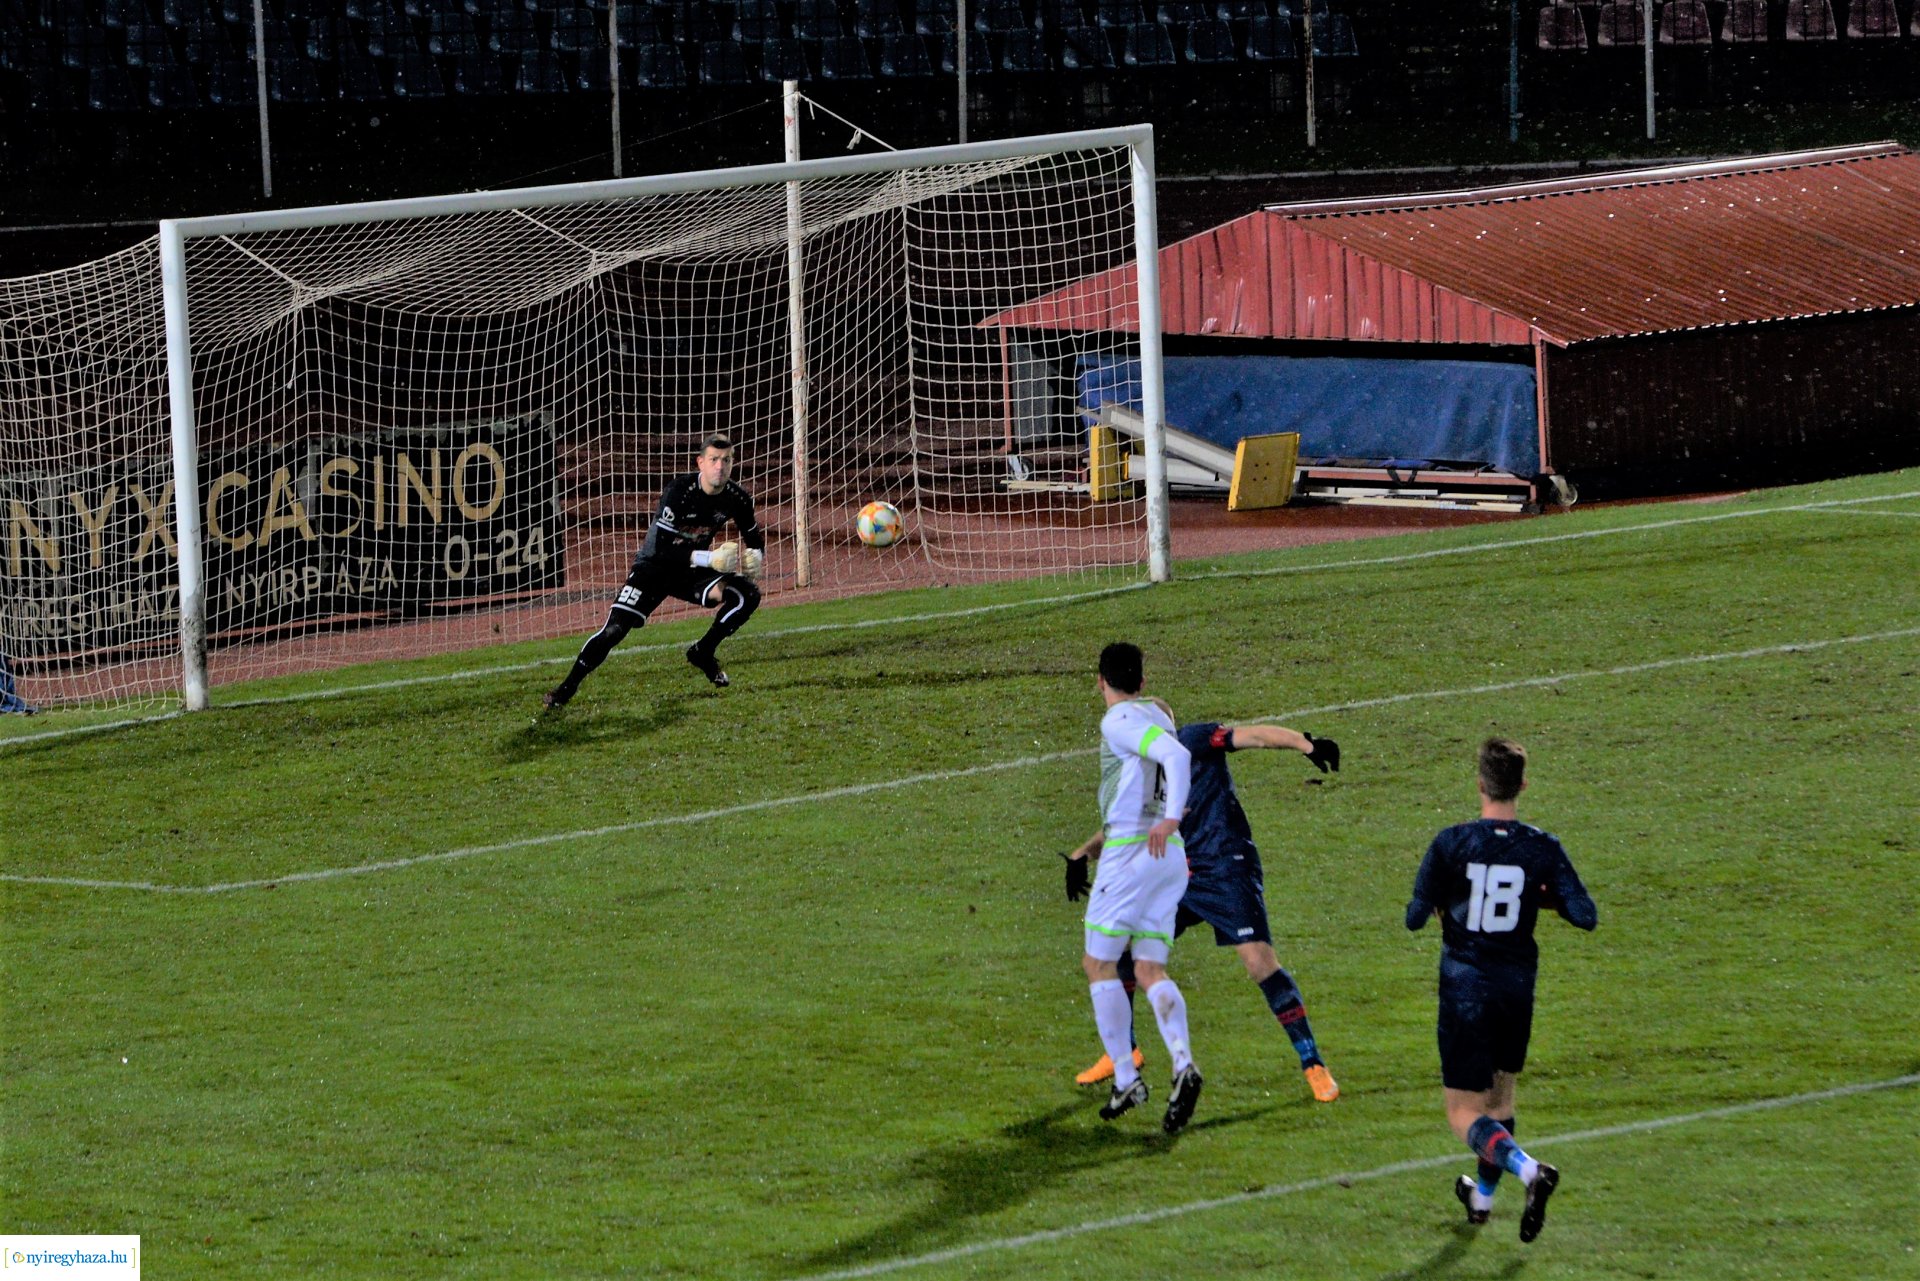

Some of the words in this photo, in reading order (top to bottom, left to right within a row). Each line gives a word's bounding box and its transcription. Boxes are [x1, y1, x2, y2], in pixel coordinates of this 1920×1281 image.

[206, 442, 505, 551] CASINO
[225, 549, 399, 610] NYÍRPÁZA
[444, 526, 548, 580] 0-24
[618, 585, 642, 606] 95
[1466, 862, 1525, 934] 18
